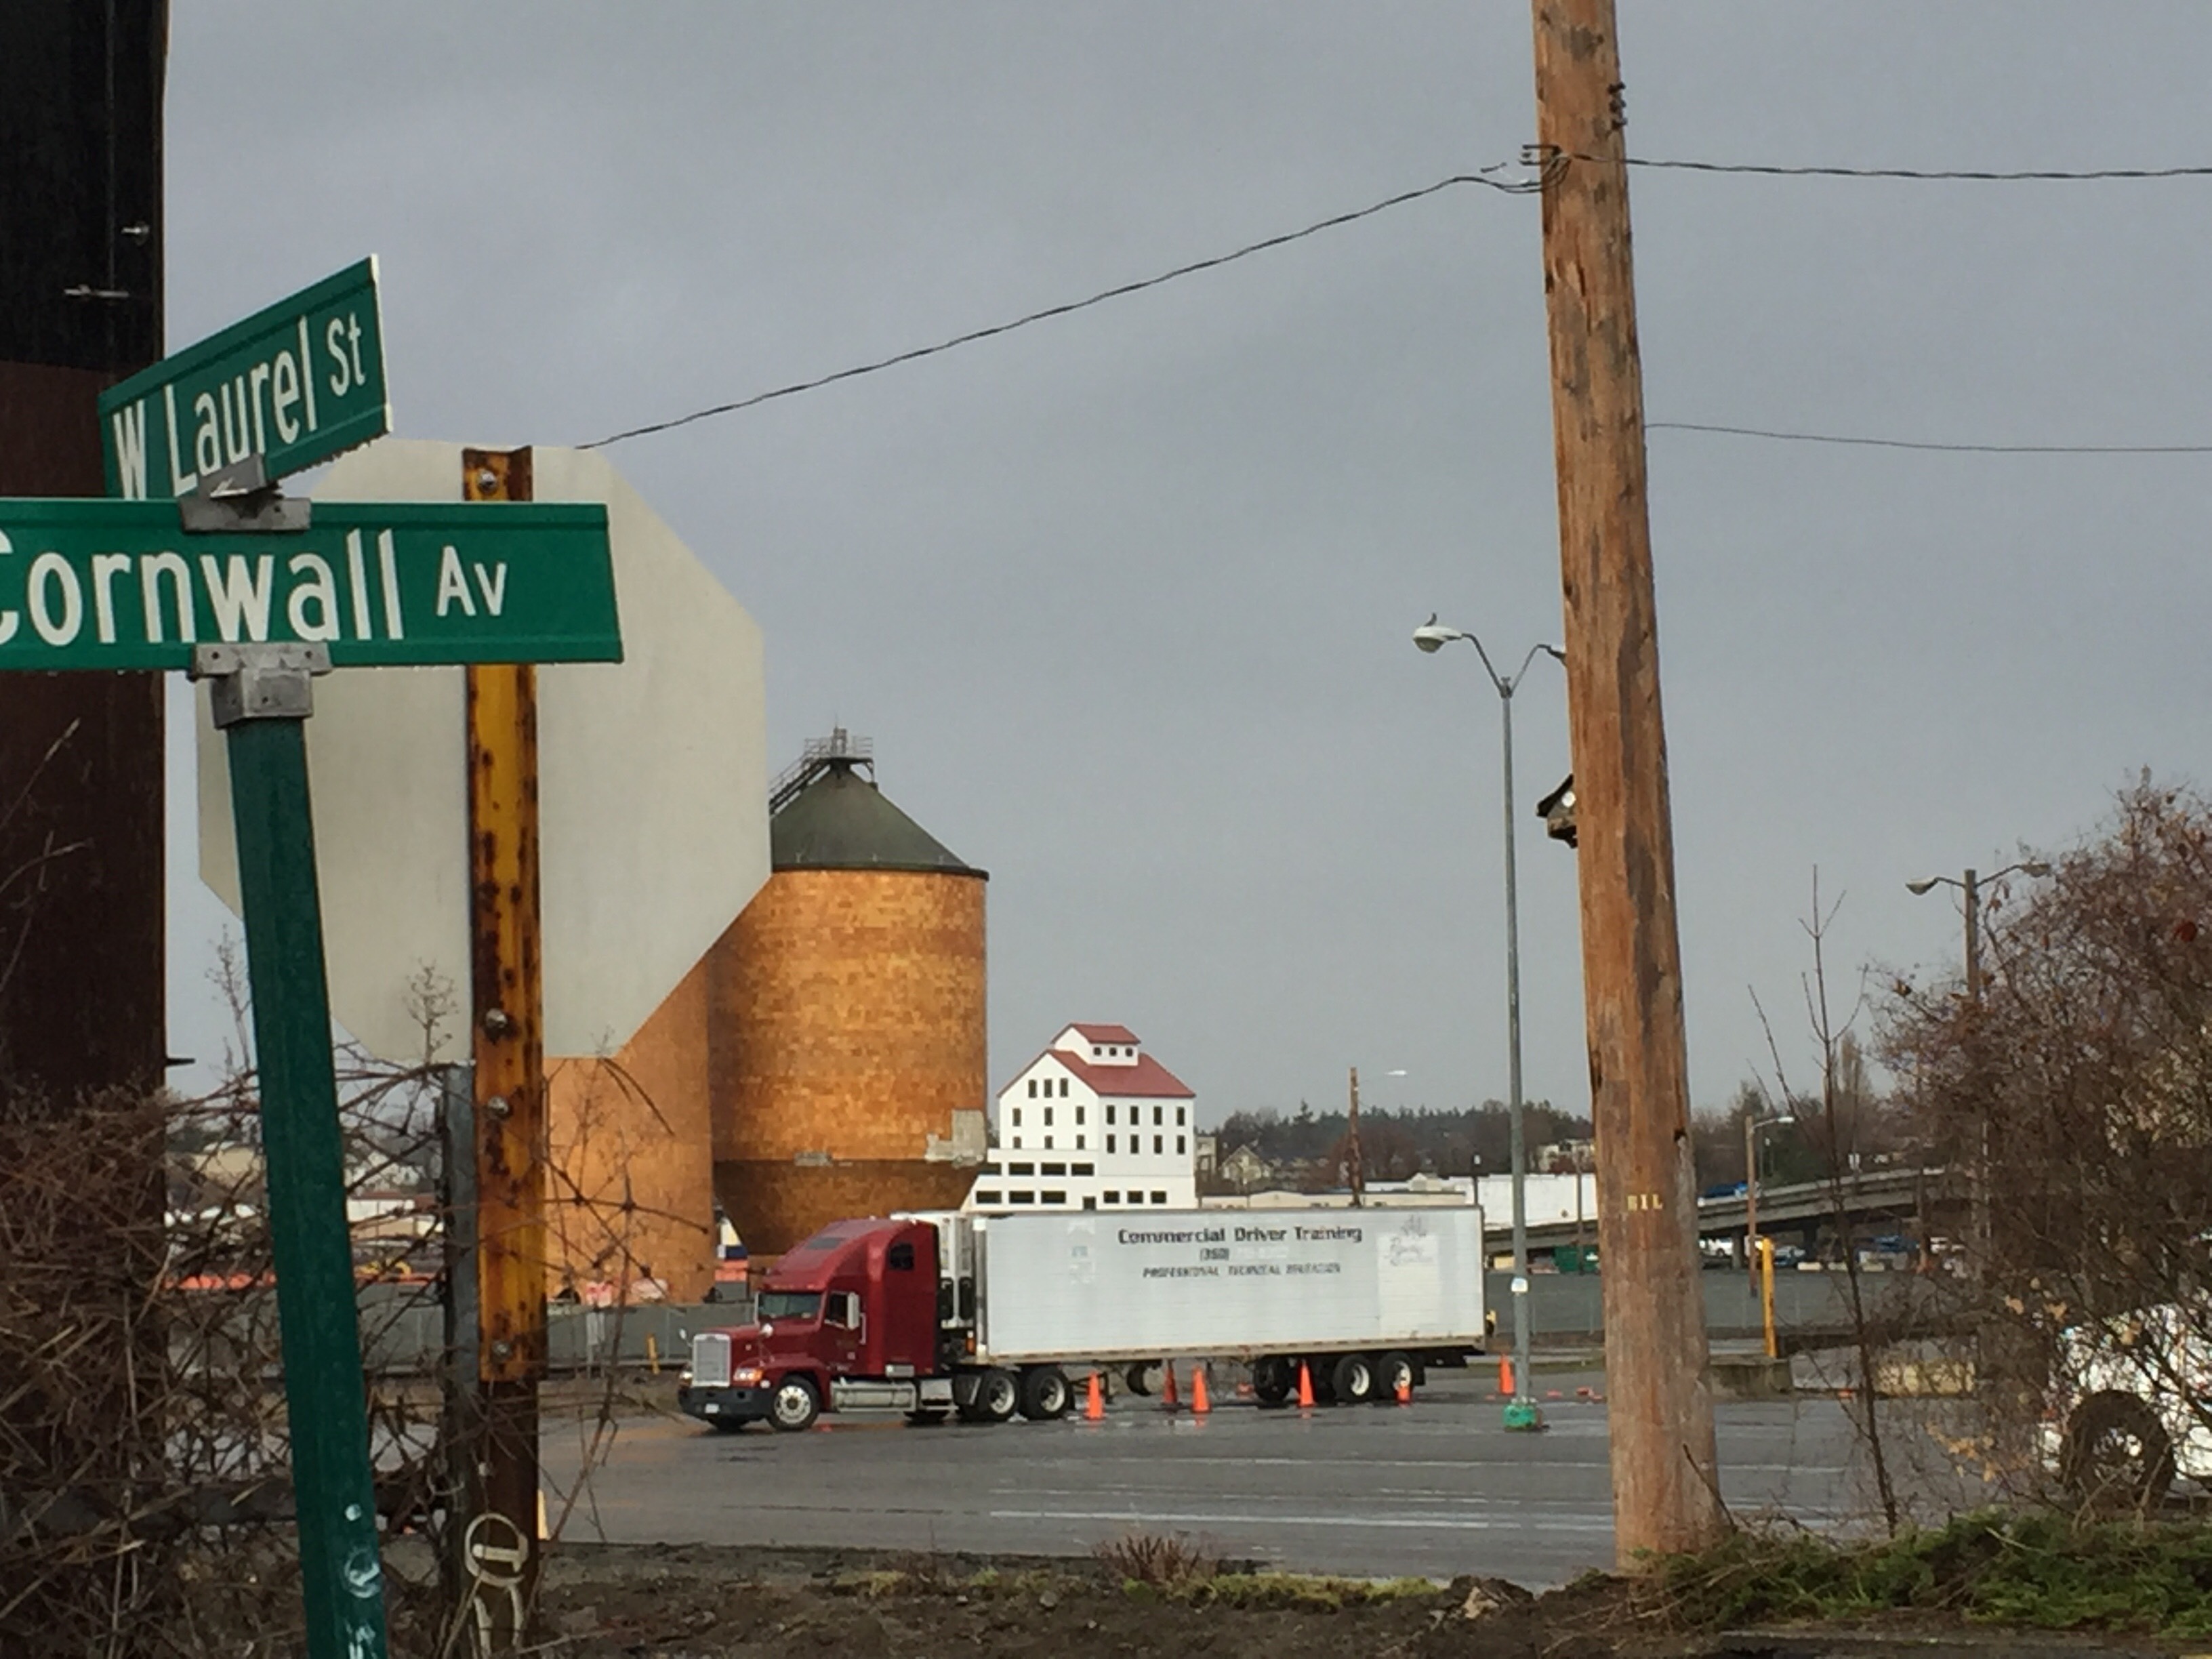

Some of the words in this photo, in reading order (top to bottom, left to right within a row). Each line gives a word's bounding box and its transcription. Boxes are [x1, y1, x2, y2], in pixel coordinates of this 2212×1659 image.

[113, 399, 146, 500] W
[164, 315, 317, 496] Laurel
[327, 312, 366, 396] St
[437, 546, 506, 616] Av
[1118, 1227, 1225, 1244] Commercial
[1234, 1227, 1286, 1242] Driver
[1294, 1225, 1362, 1243] Training
